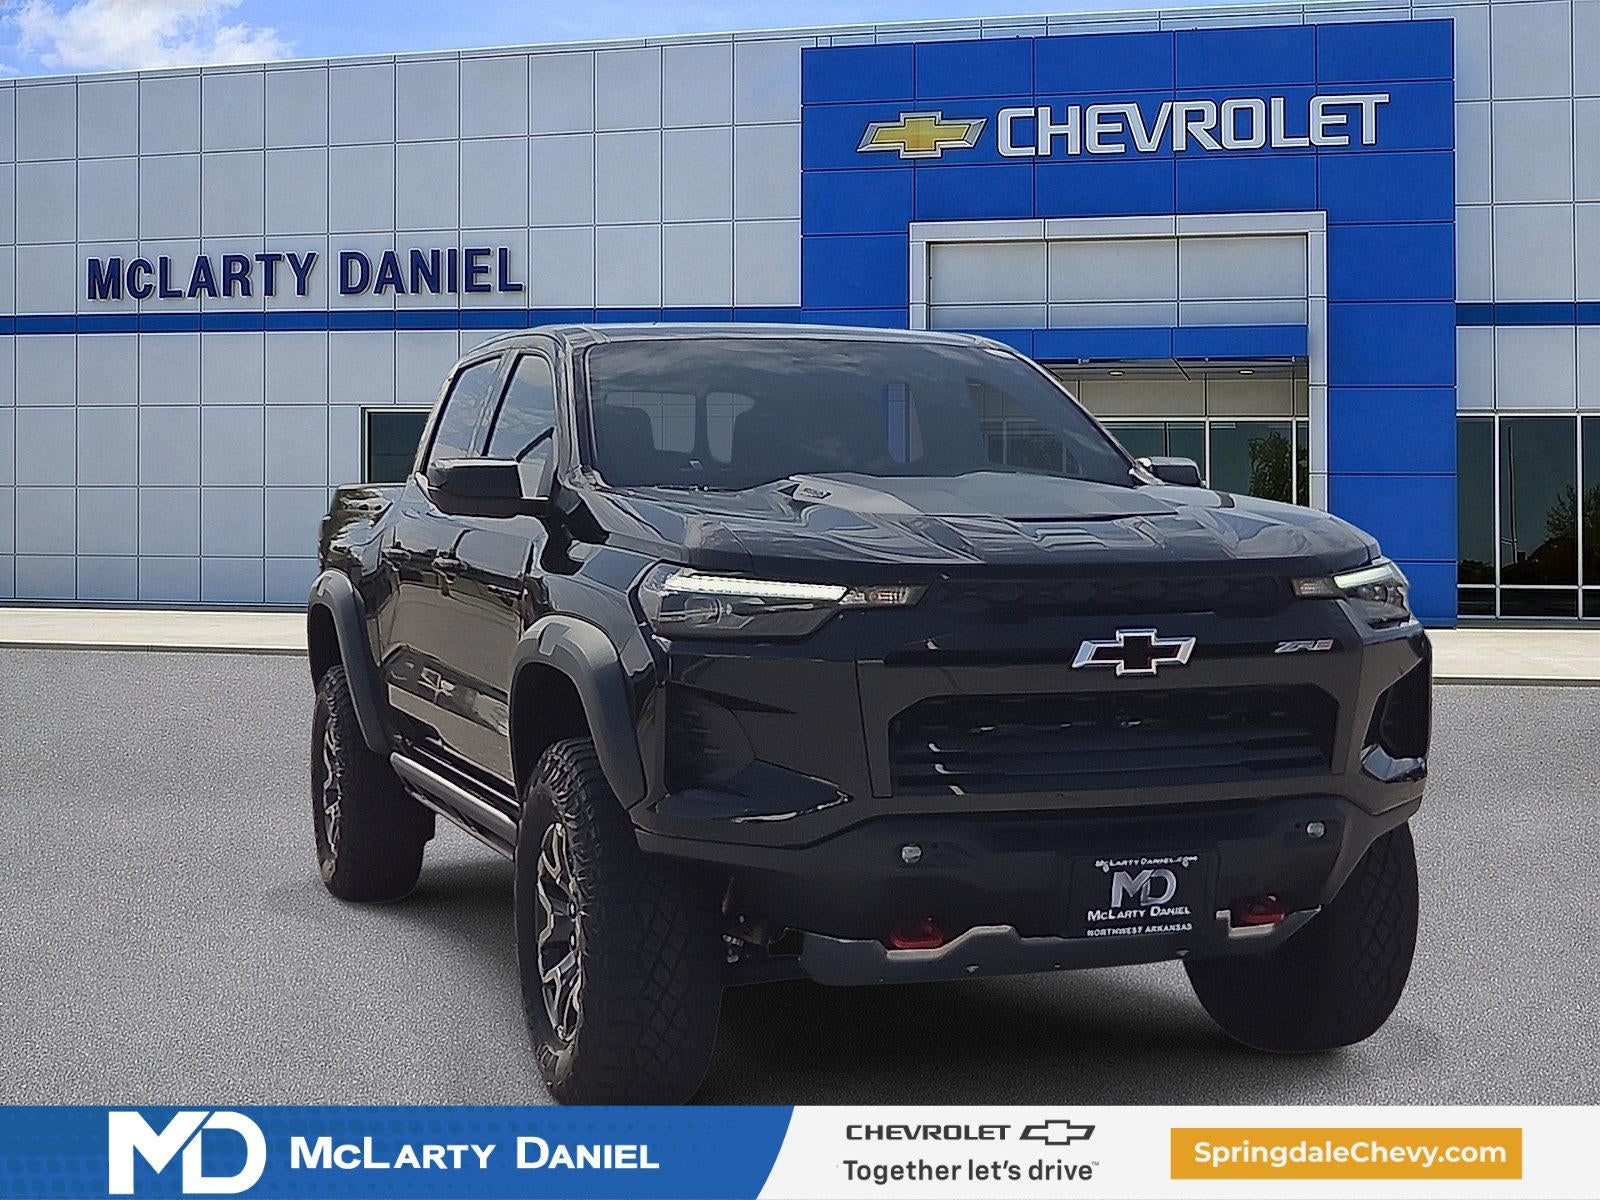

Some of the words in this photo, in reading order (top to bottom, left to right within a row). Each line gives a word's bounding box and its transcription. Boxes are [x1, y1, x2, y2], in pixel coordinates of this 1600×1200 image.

[997, 93, 1390, 158] CHEVROLET
[87, 251, 318, 301] MCLARTY
[339, 246, 525, 296] DANIEL
[1110, 868, 1177, 908] MD
[1086, 926, 1143, 937] NORTHWEST
[1144, 922, 1193, 934] ARKANSAS
[1149, 905, 1192, 917] DANIEL
